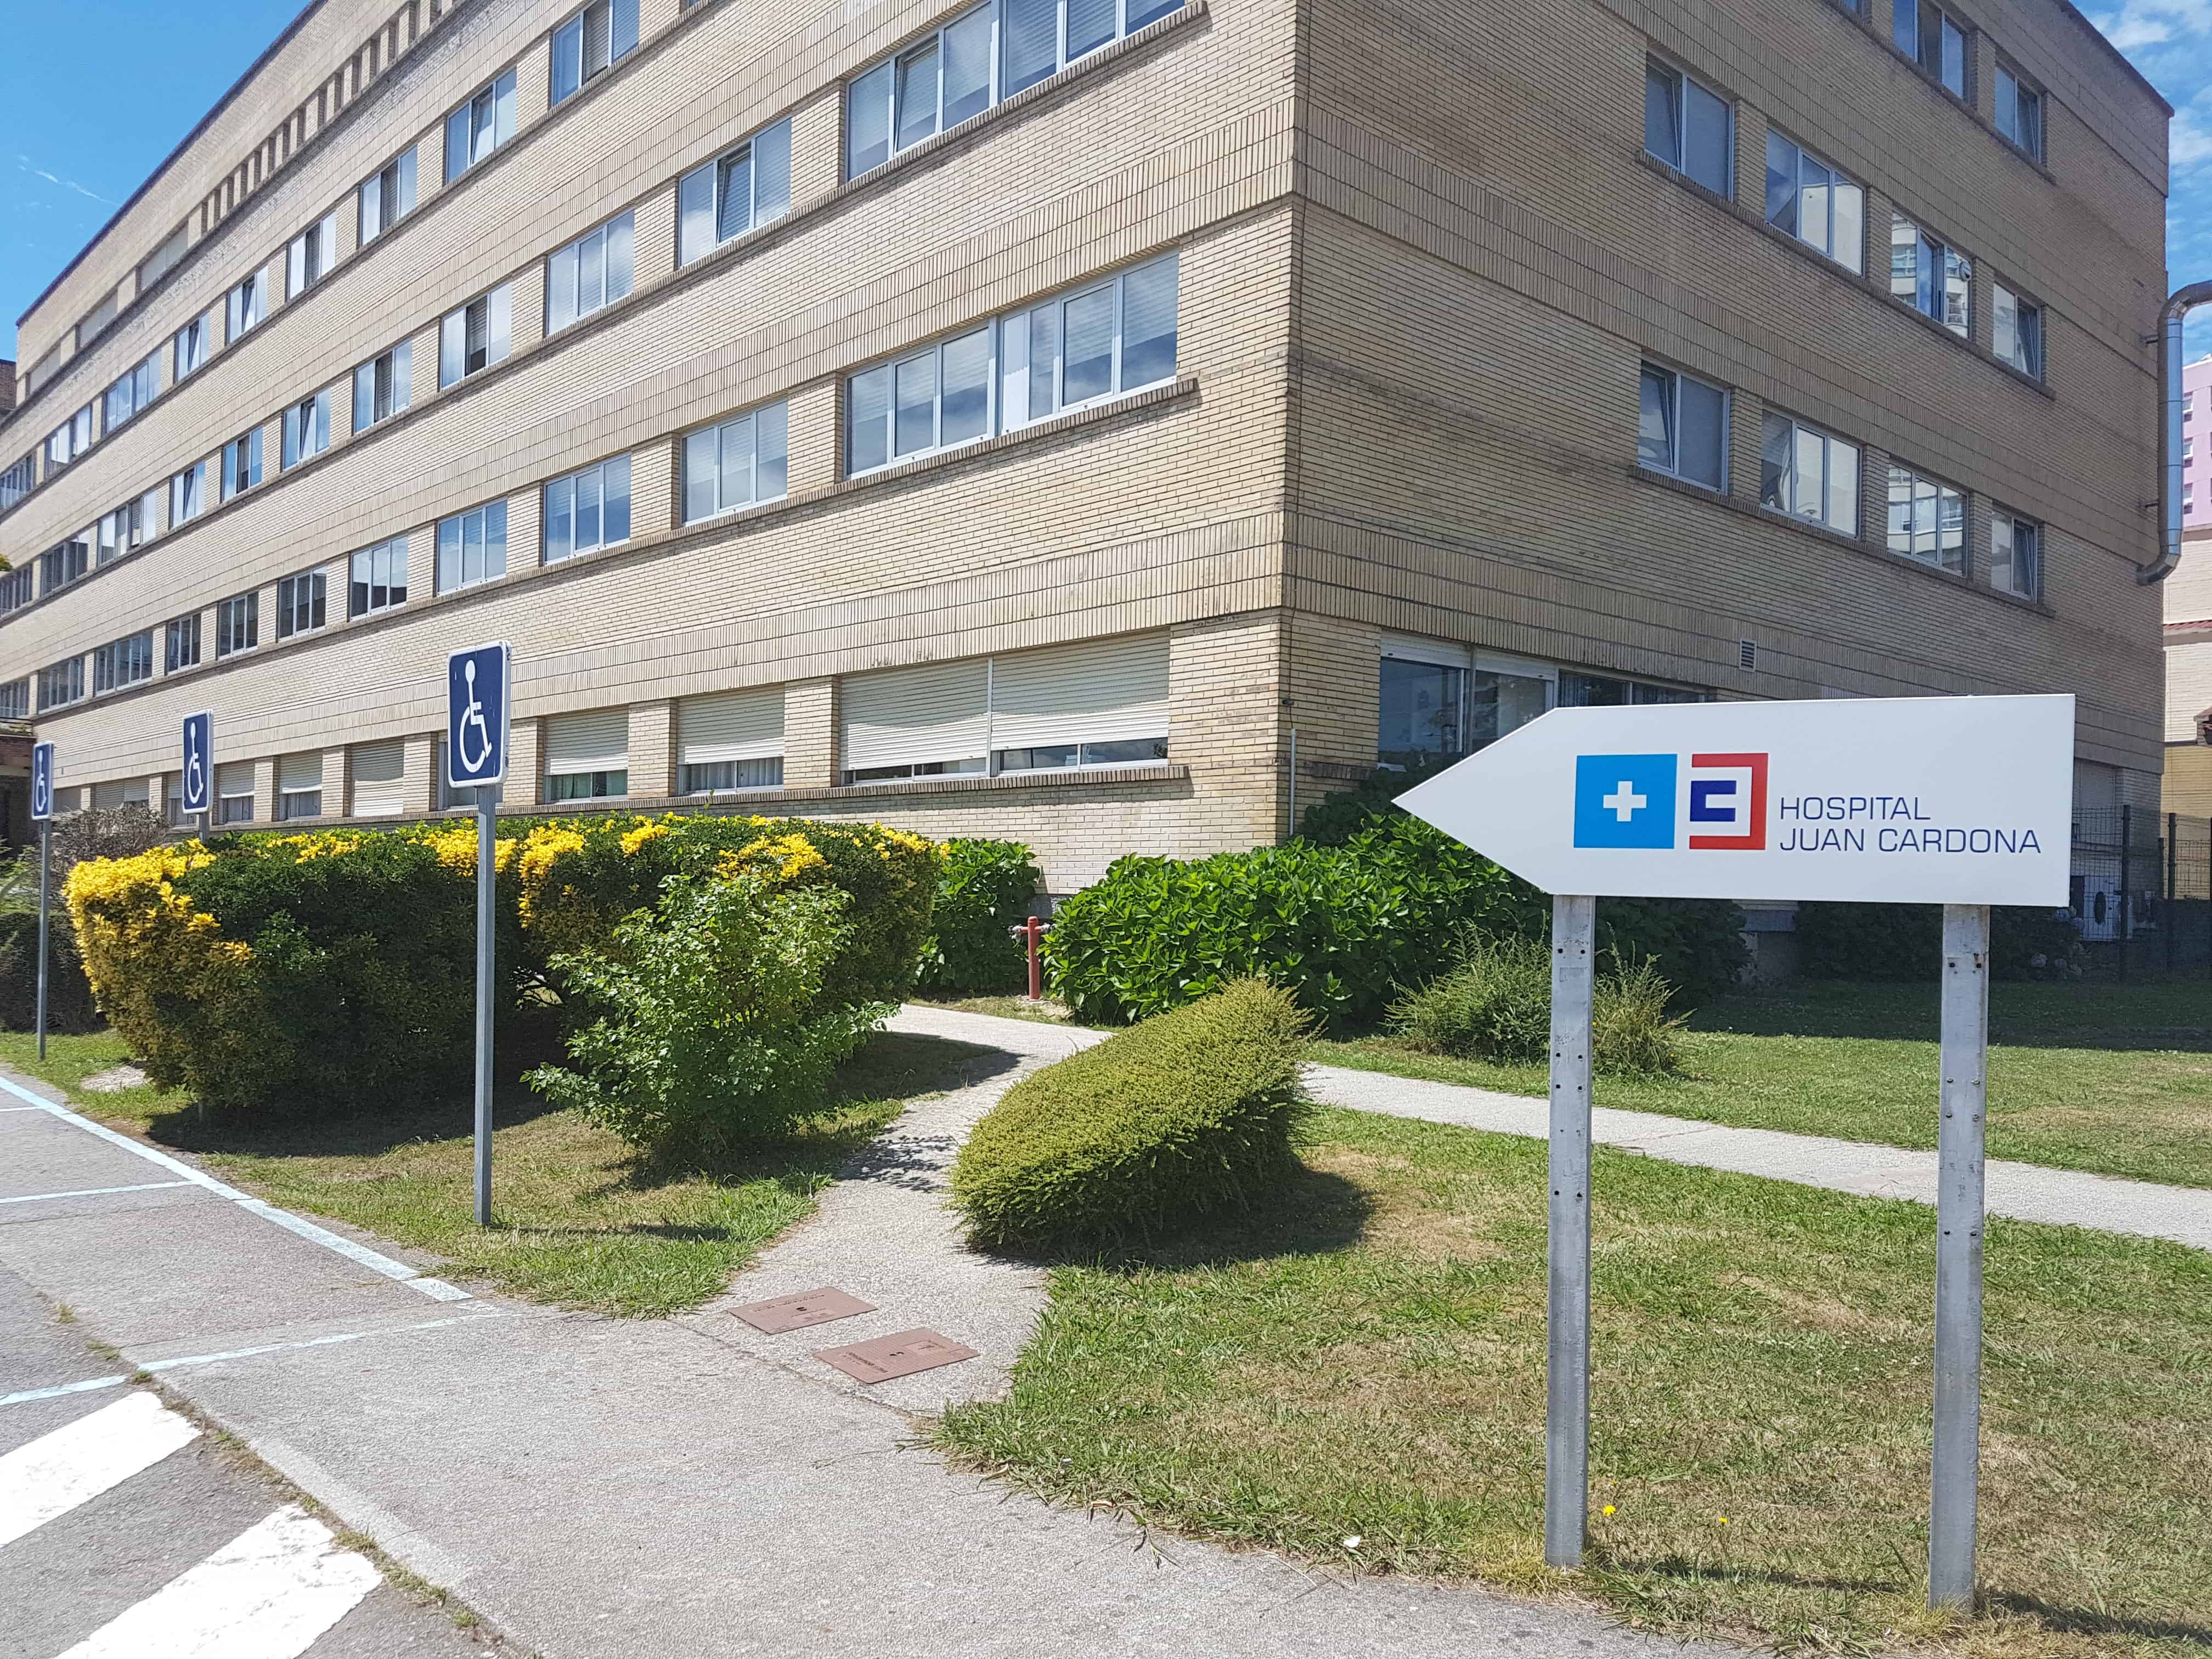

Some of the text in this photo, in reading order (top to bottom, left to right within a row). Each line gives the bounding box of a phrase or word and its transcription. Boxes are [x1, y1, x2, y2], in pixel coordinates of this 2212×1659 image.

[1780, 796, 1931, 820] HOSPITAL
[1780, 827, 2041, 854] JUAN CARDONA
